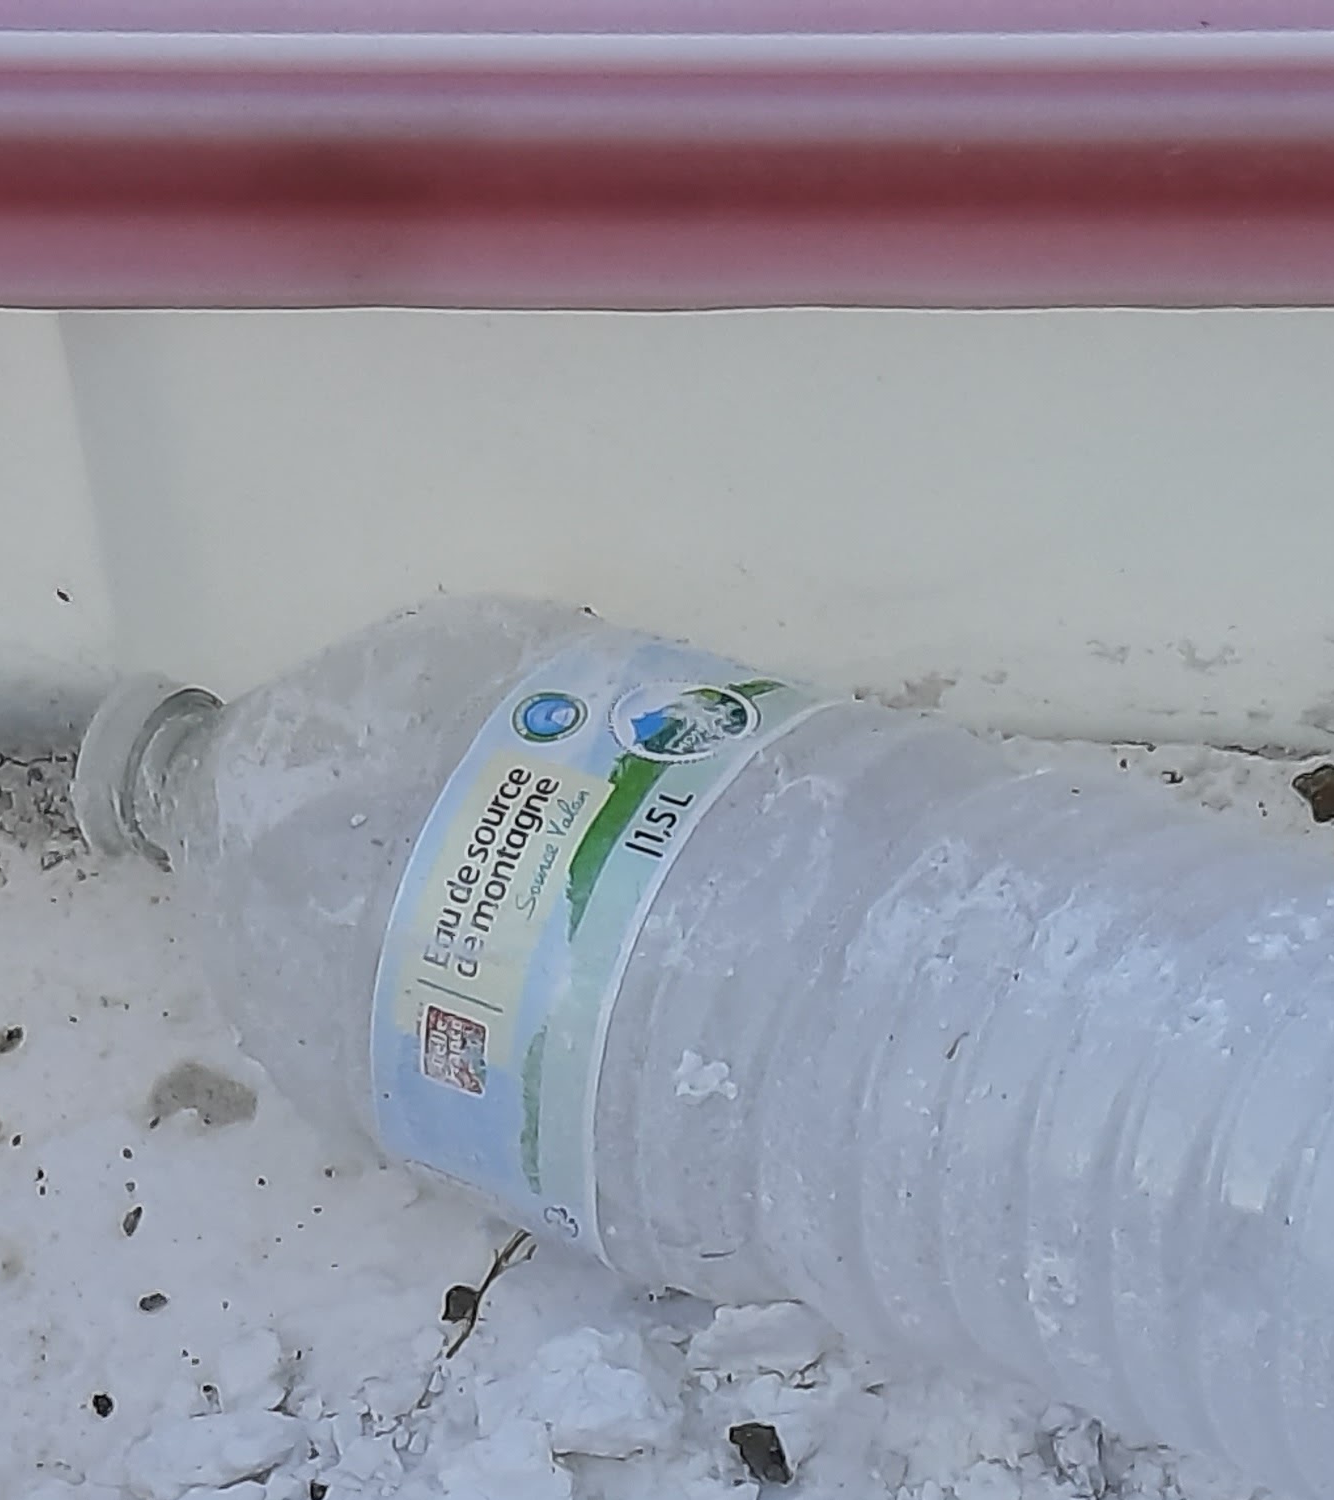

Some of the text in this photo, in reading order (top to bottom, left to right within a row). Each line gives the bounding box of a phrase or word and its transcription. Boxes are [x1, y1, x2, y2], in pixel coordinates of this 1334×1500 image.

[423, 767, 532, 969] Eau de source
[457, 777, 560, 978] de montagne
[517, 844, 559, 921] Source
